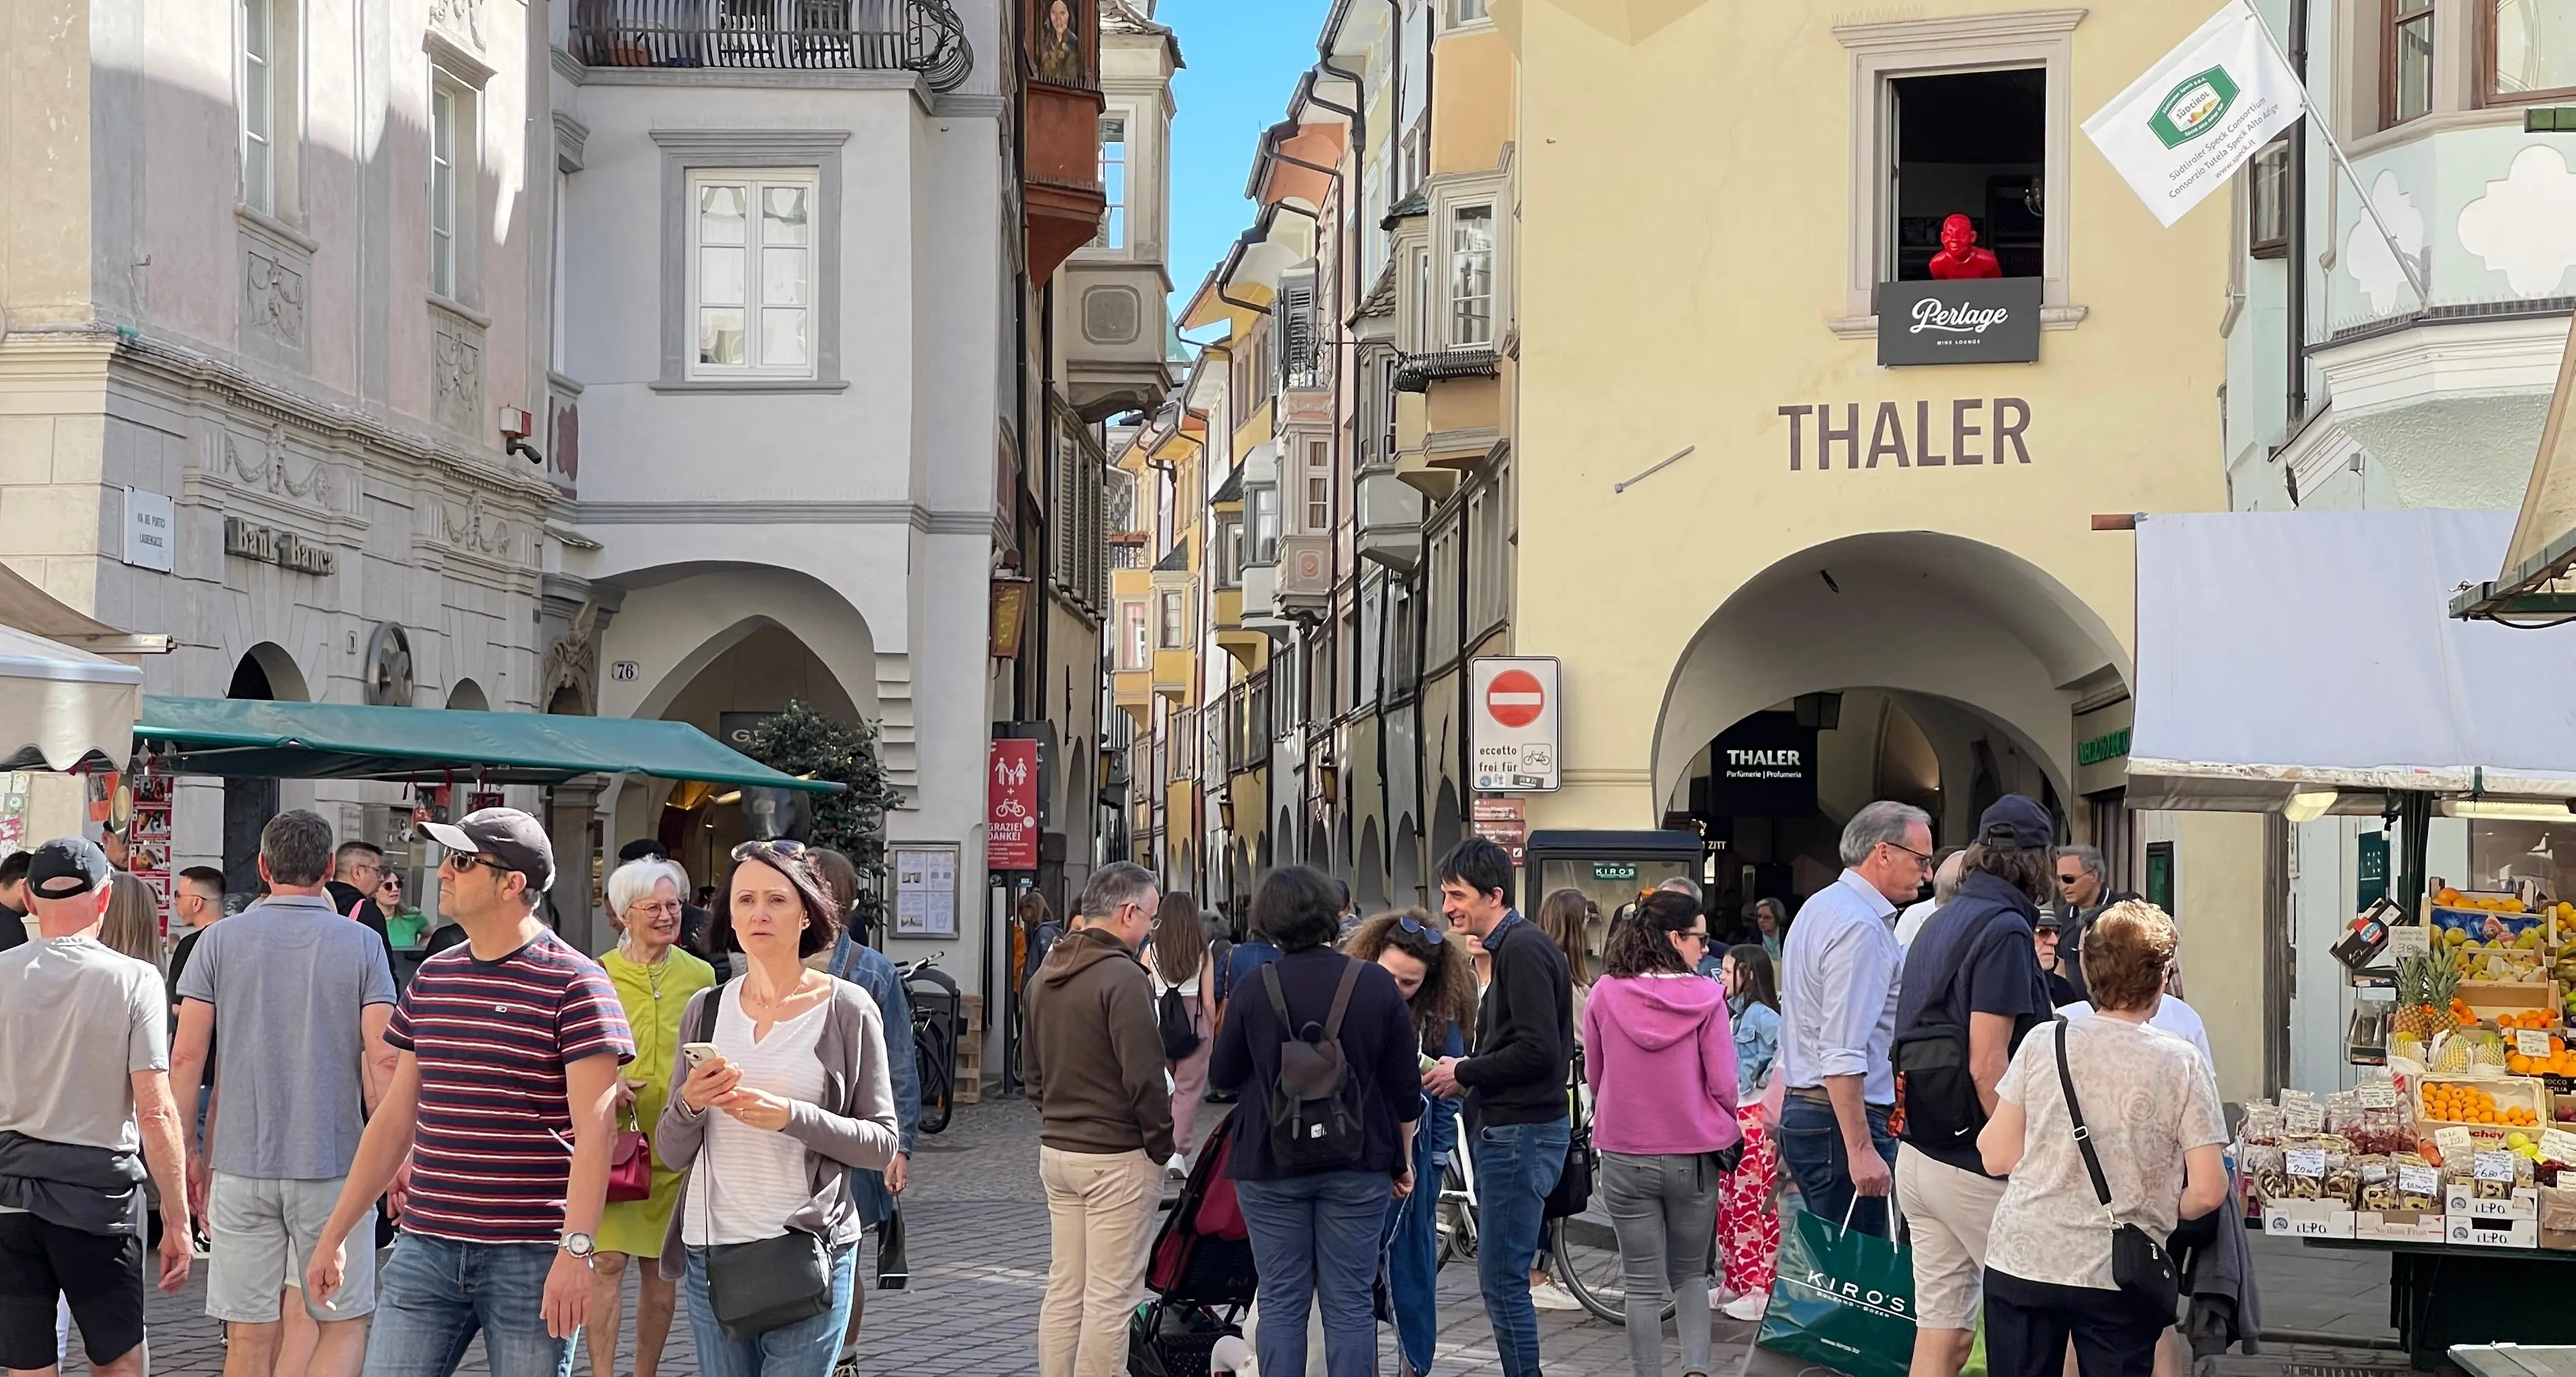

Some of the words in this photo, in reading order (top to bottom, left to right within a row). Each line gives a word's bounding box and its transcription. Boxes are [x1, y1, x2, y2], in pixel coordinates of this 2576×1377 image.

[2169, 149, 2206, 181] Südtiroler
[2205, 131, 2228, 152] Speck
[2227, 97, 2266, 133] Consortium
[2169, 168, 2206, 199] Consorzio
[2204, 149, 2228, 169] Tutela
[2226, 130, 2247, 152] Speck
[2247, 117, 2263, 131] Alto
[2262, 103, 2279, 120] Adige
[2214, 139, 2256, 179] www.speck.it
[1909, 298, 2008, 334] Perlage
[1778, 397, 2032, 472] THALER
[235, 517, 279, 561] Bank
[288, 531, 335, 575] Banca
[617, 663, 634, 679] 76
[1479, 745, 1517, 755] eccetto
[1727, 749, 1801, 766] THALER
[1479, 761, 1497, 772] frei
[1502, 761, 1517, 772] für
[1726, 770, 1762, 778] Parfümerie
[988, 822, 1022, 832] GRAZIE!
[988, 832, 1021, 841] DANKE!
[1807, 1269, 1905, 1313] KIRO'S
[1816, 1291, 1854, 1307] BOLZANO
[1862, 1307, 1890, 1318] BOZEN
